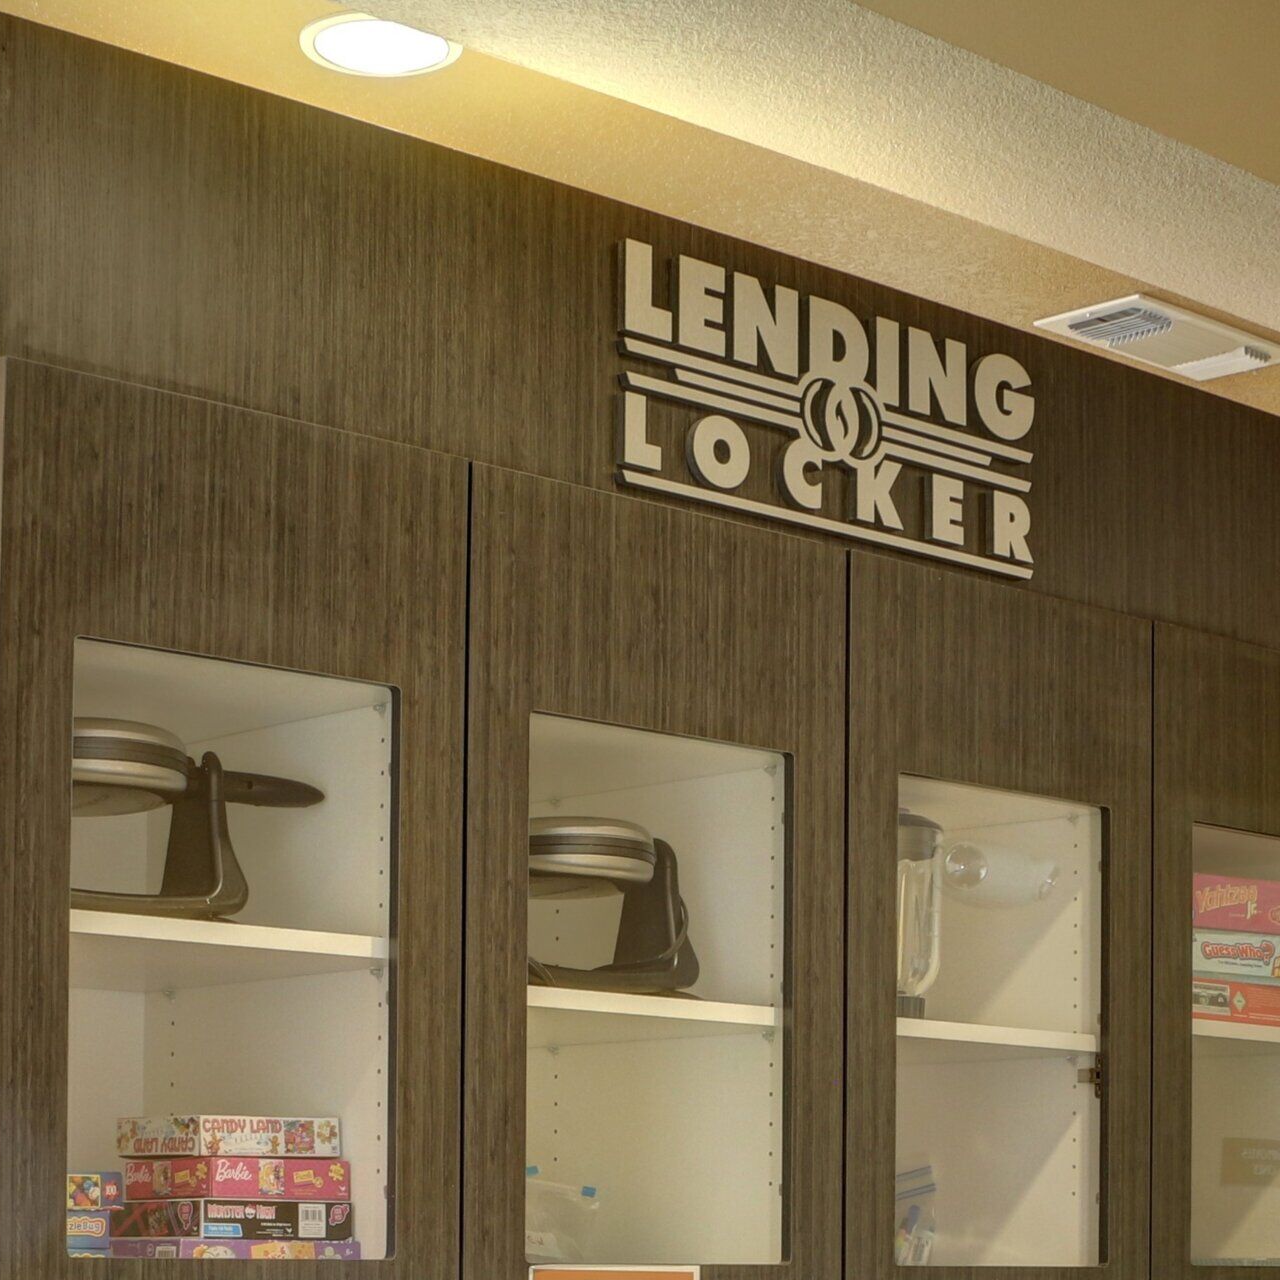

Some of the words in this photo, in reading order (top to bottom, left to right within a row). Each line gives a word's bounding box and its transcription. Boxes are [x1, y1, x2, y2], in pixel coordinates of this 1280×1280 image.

[625, 238, 1035, 440] LENDING
[624, 391, 1035, 563] LOCKER
[202, 1119, 246, 1133] CANDY
[250, 1119, 282, 1133] LAND
[215, 1160, 252, 1181] Barbie
